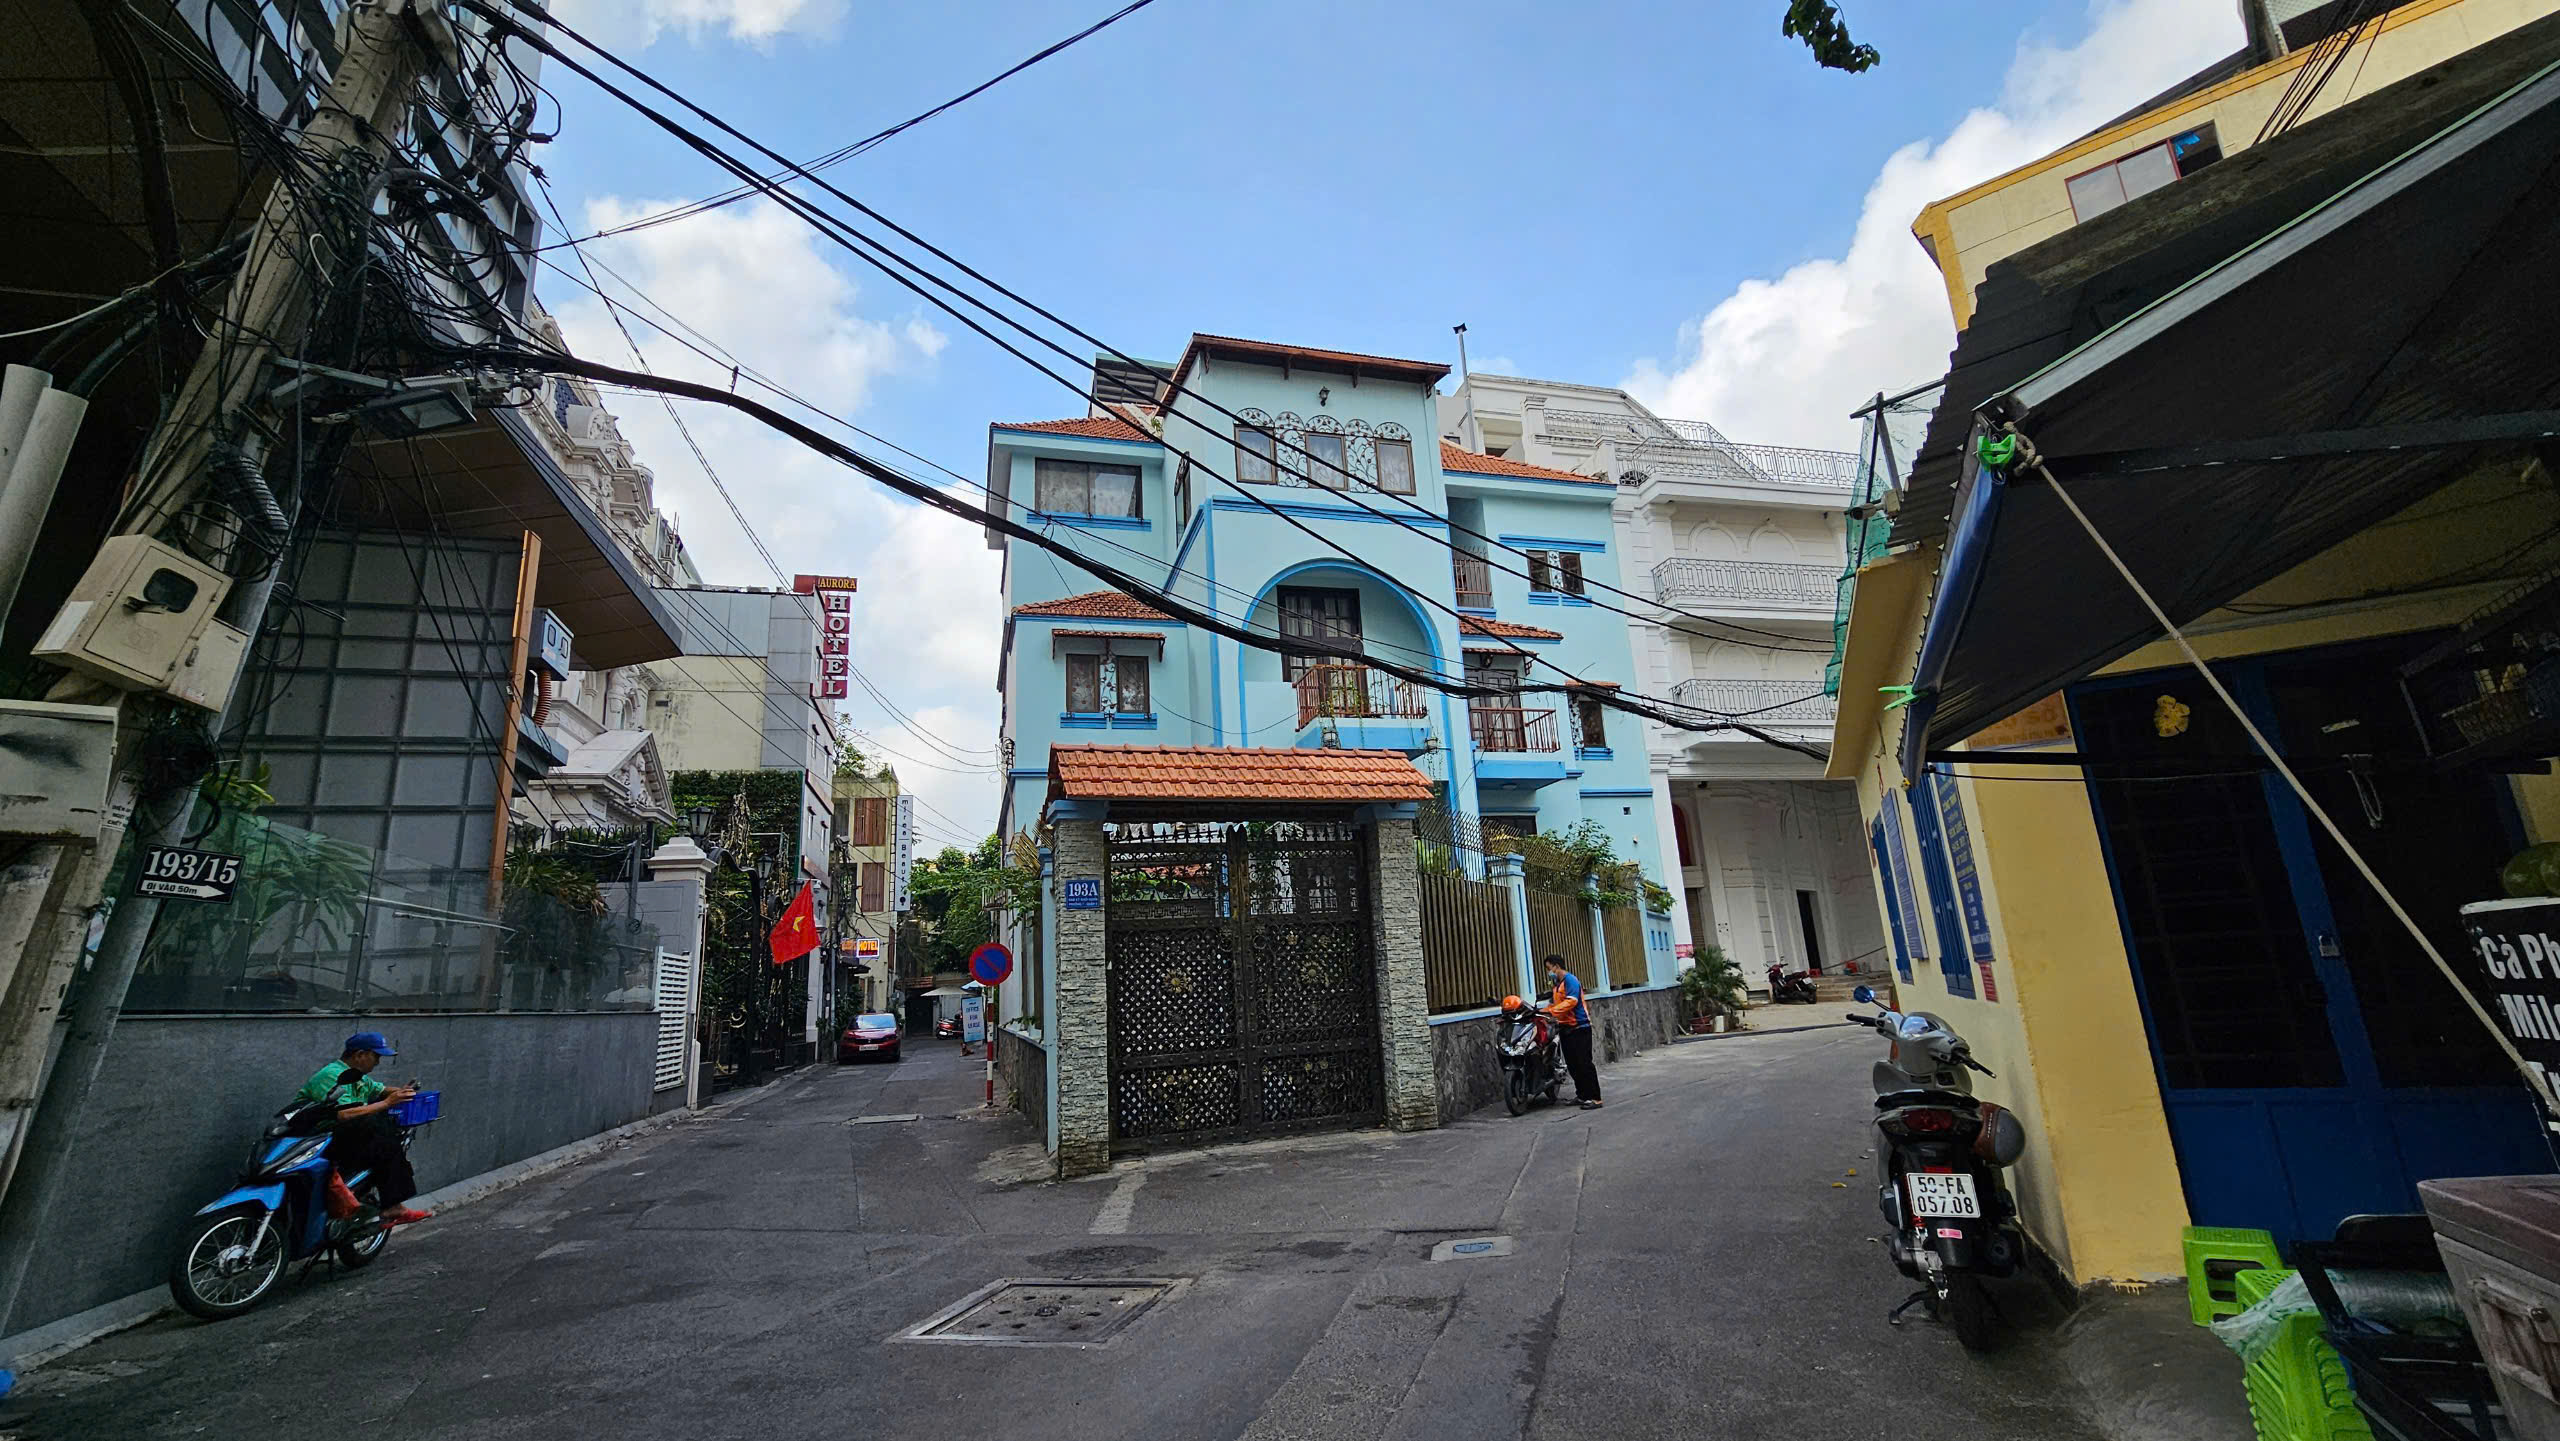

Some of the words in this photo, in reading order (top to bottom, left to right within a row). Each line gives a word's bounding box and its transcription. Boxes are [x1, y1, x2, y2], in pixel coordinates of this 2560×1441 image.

[820, 578, 857, 589] AURORA
[826, 596, 848, 696] HOTEL
[145, 850, 240, 884] 193/15
[177, 885, 198, 894] 50m
[1068, 882, 1099, 897] 193A
[859, 940, 879, 951] HOTEL
[2480, 934, 2526, 980] Cà
[1917, 1195, 1975, 1215] 057.08
